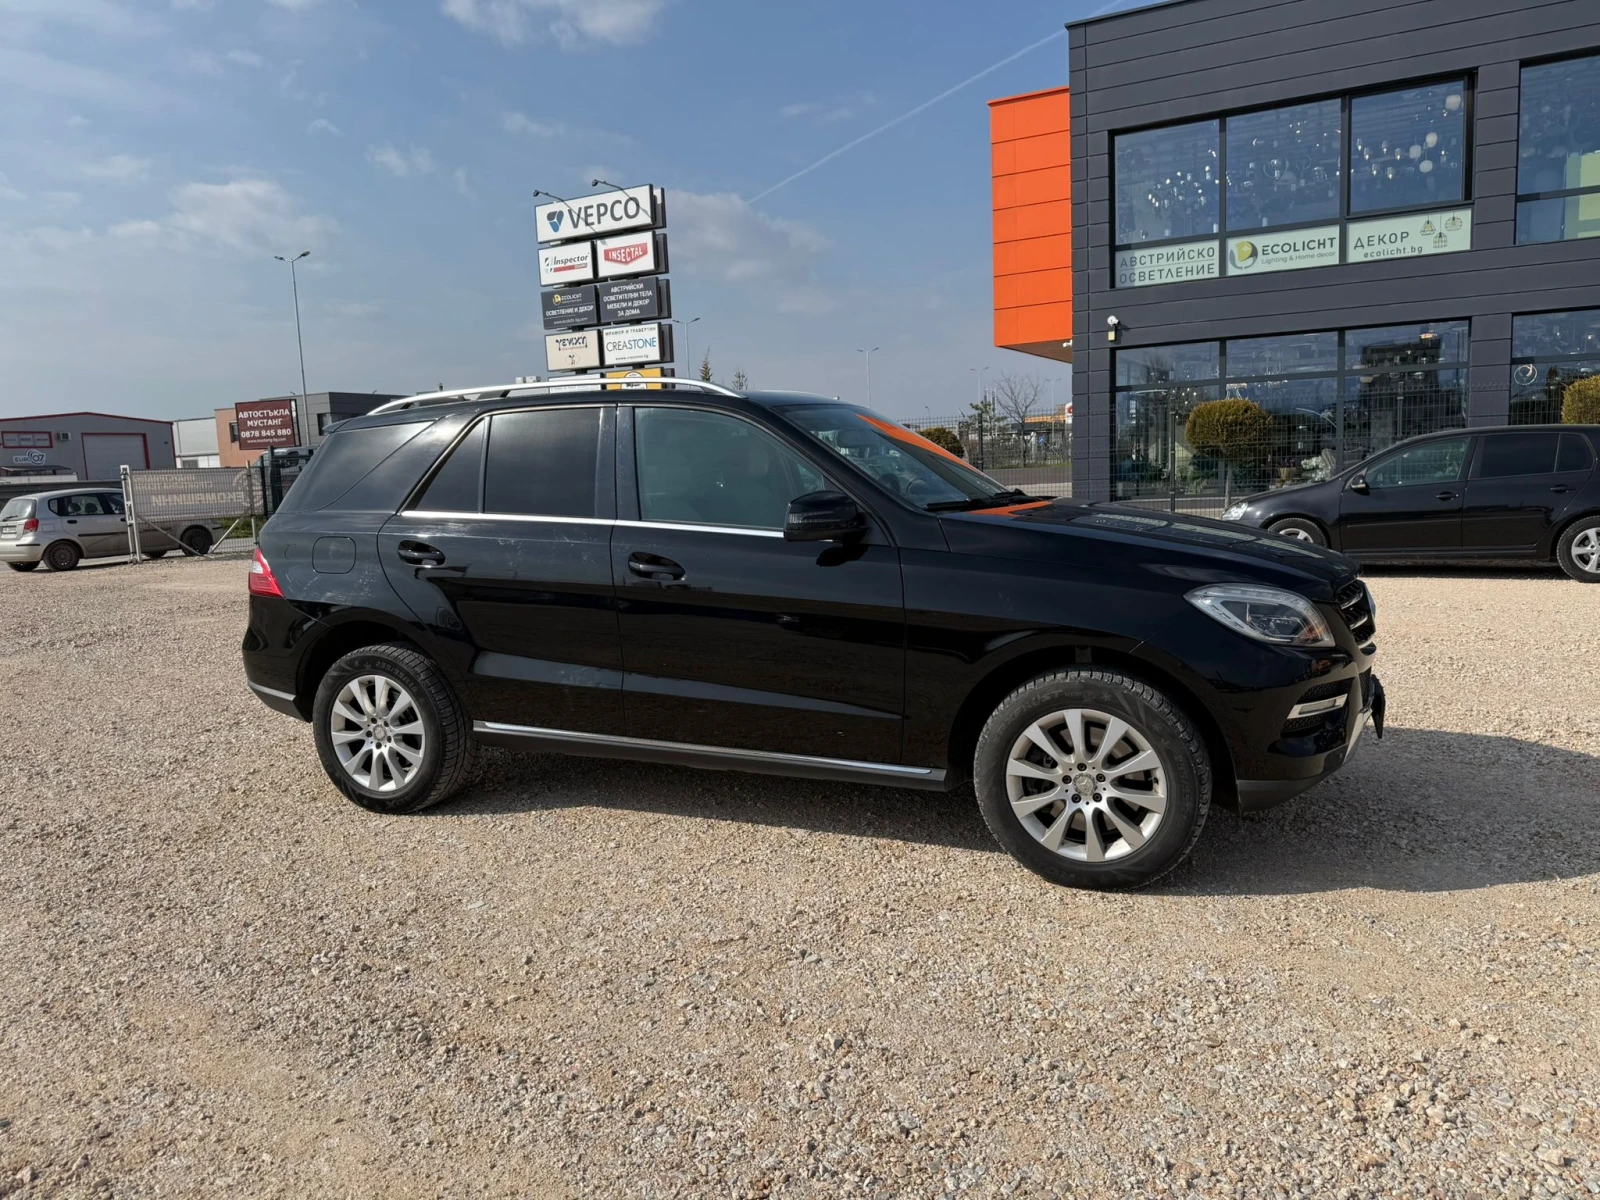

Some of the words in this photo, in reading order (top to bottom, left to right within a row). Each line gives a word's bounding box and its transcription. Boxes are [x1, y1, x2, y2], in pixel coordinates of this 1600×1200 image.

[567, 196, 640, 229] VEPCO
[1261, 237, 1336, 256] ECOLICHT
[1353, 231, 1410, 250] ДЕКОР
[608, 246, 643, 262] INSECTAL
[1119, 246, 1215, 269] АВСТРИЙСКО
[1363, 245, 1423, 259] ecolicht.bg
[553, 255, 589, 266] Inspector
[1261, 256, 1288, 265] Lighting
[1295, 253, 1315, 261] Home
[1119, 263, 1215, 284] ОСВЕТЛЕНИЕ
[610, 282, 644, 293] АВСТРИЙСКИ
[632, 298, 650, 307] ДЕКОР
[545, 307, 575, 317] ОСВЕТЛЕНИЕ
[578, 304, 594, 313] ДЕКОР
[624, 308, 641, 317] ДОМА
[605, 336, 657, 352] CREASTONE
[238, 408, 290, 419] АВТОСТЪКЛА
[247, 418, 283, 427] МУСТАНГ
[240, 430, 260, 438] 0878
[277, 428, 292, 436] 880
